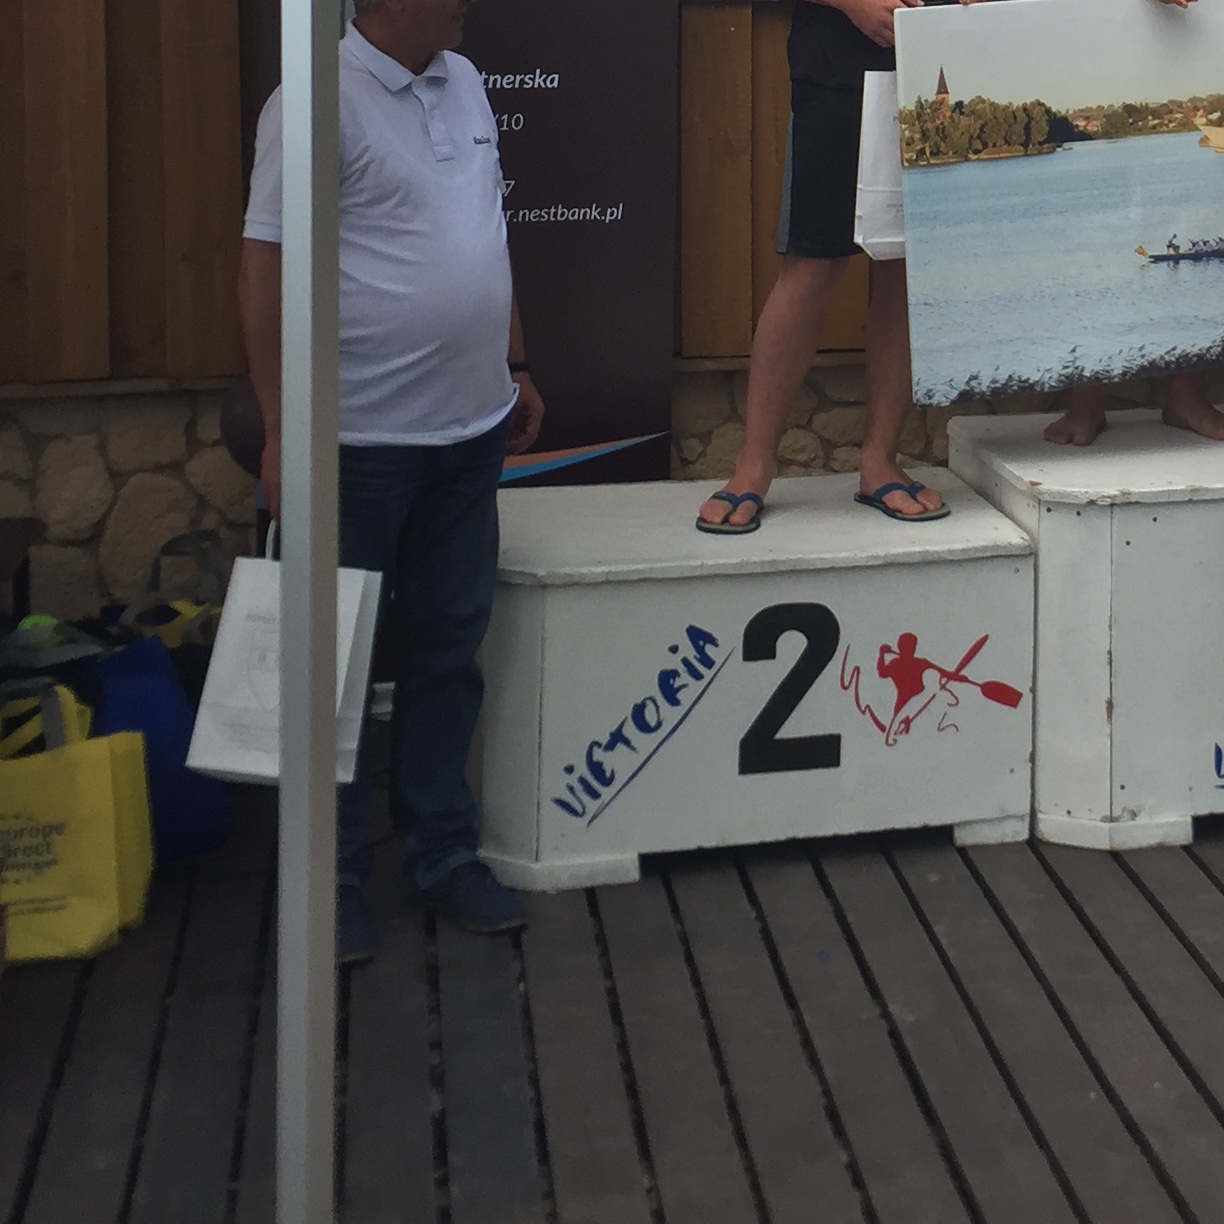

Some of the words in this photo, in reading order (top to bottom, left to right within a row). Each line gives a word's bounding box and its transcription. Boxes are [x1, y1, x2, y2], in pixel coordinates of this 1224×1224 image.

[481, 68, 560, 89] tnerska
[496, 113, 525, 130] 10
[505, 203, 623, 223] r.nestbank.pl
[738, 602, 840, 774] 2
